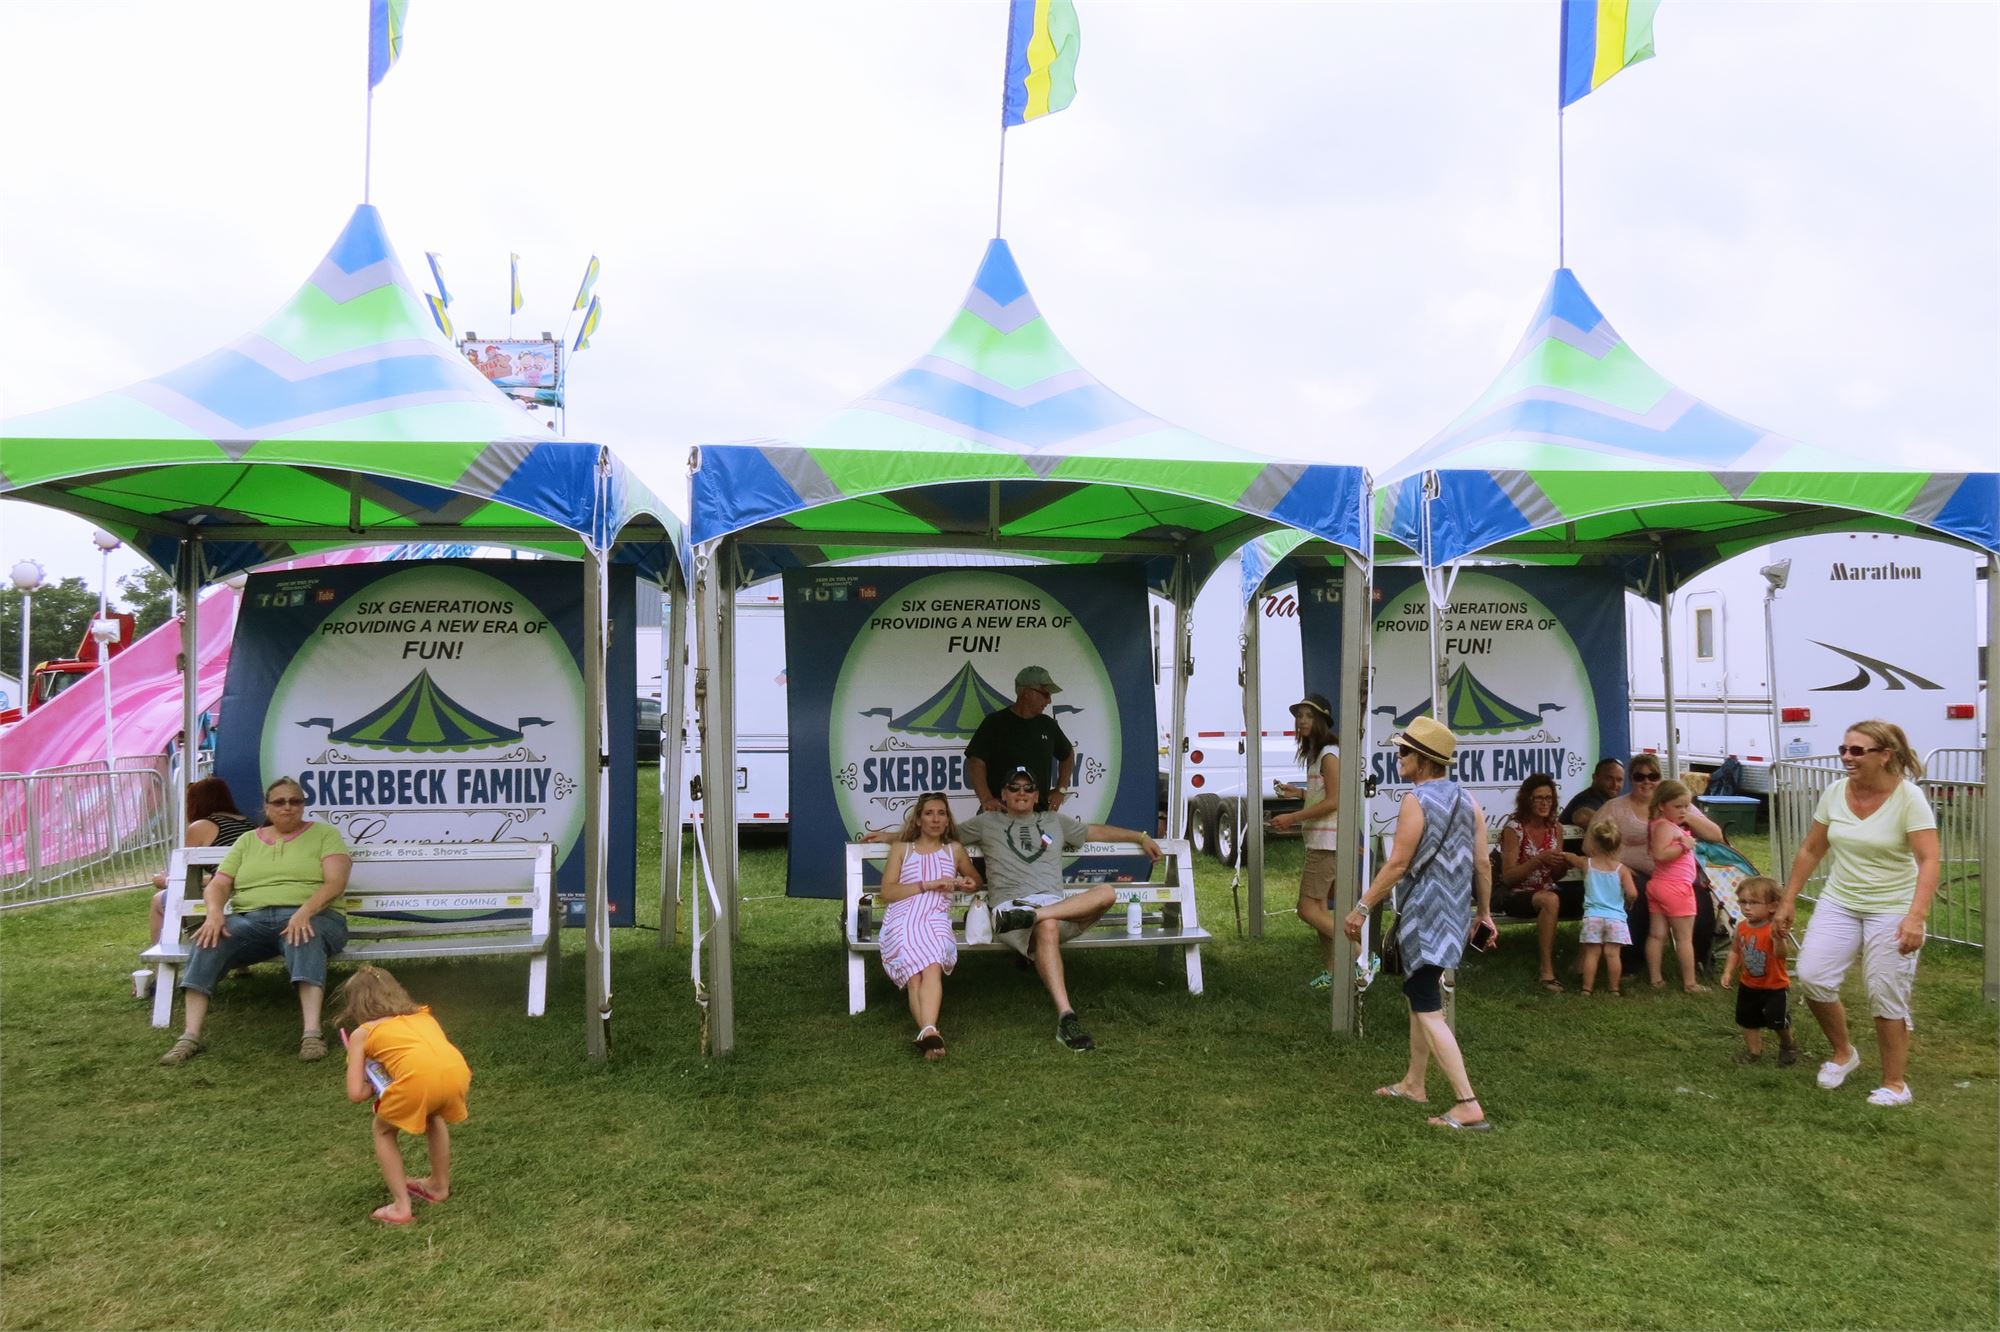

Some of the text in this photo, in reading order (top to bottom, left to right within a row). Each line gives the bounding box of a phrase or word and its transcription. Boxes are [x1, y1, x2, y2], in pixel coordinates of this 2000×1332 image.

[1830, 562, 1921, 580] Marathon
[357, 600, 514, 615] SIX GENERATIONS
[901, 599, 1041, 612] SIX GENERATIONS
[1403, 603, 1528, 615] SIX NERATIONS
[322, 620, 548, 635] PROVIDING A NEW ERA OF
[870, 616, 1073, 630] PROVIDING A NEW ERA OF
[1376, 619, 1556, 632] PROVIDG A NEW ERA OF
[402, 641, 464, 660] FUN!
[948, 636, 1001, 653] FUN!
[1446, 638, 1492, 655] FUN!
[1372, 748, 1565, 784] SKECK FAMILY
[863, 756, 974, 792] SKERBEC
[299, 768, 552, 806] SKERBECK FAMILY
[350, 846, 469, 857] erbeck Bros. Shows
[1084, 844, 1115, 853] Shows
[375, 899, 419, 908] THANKS
[454, 897, 497, 906] COMING
